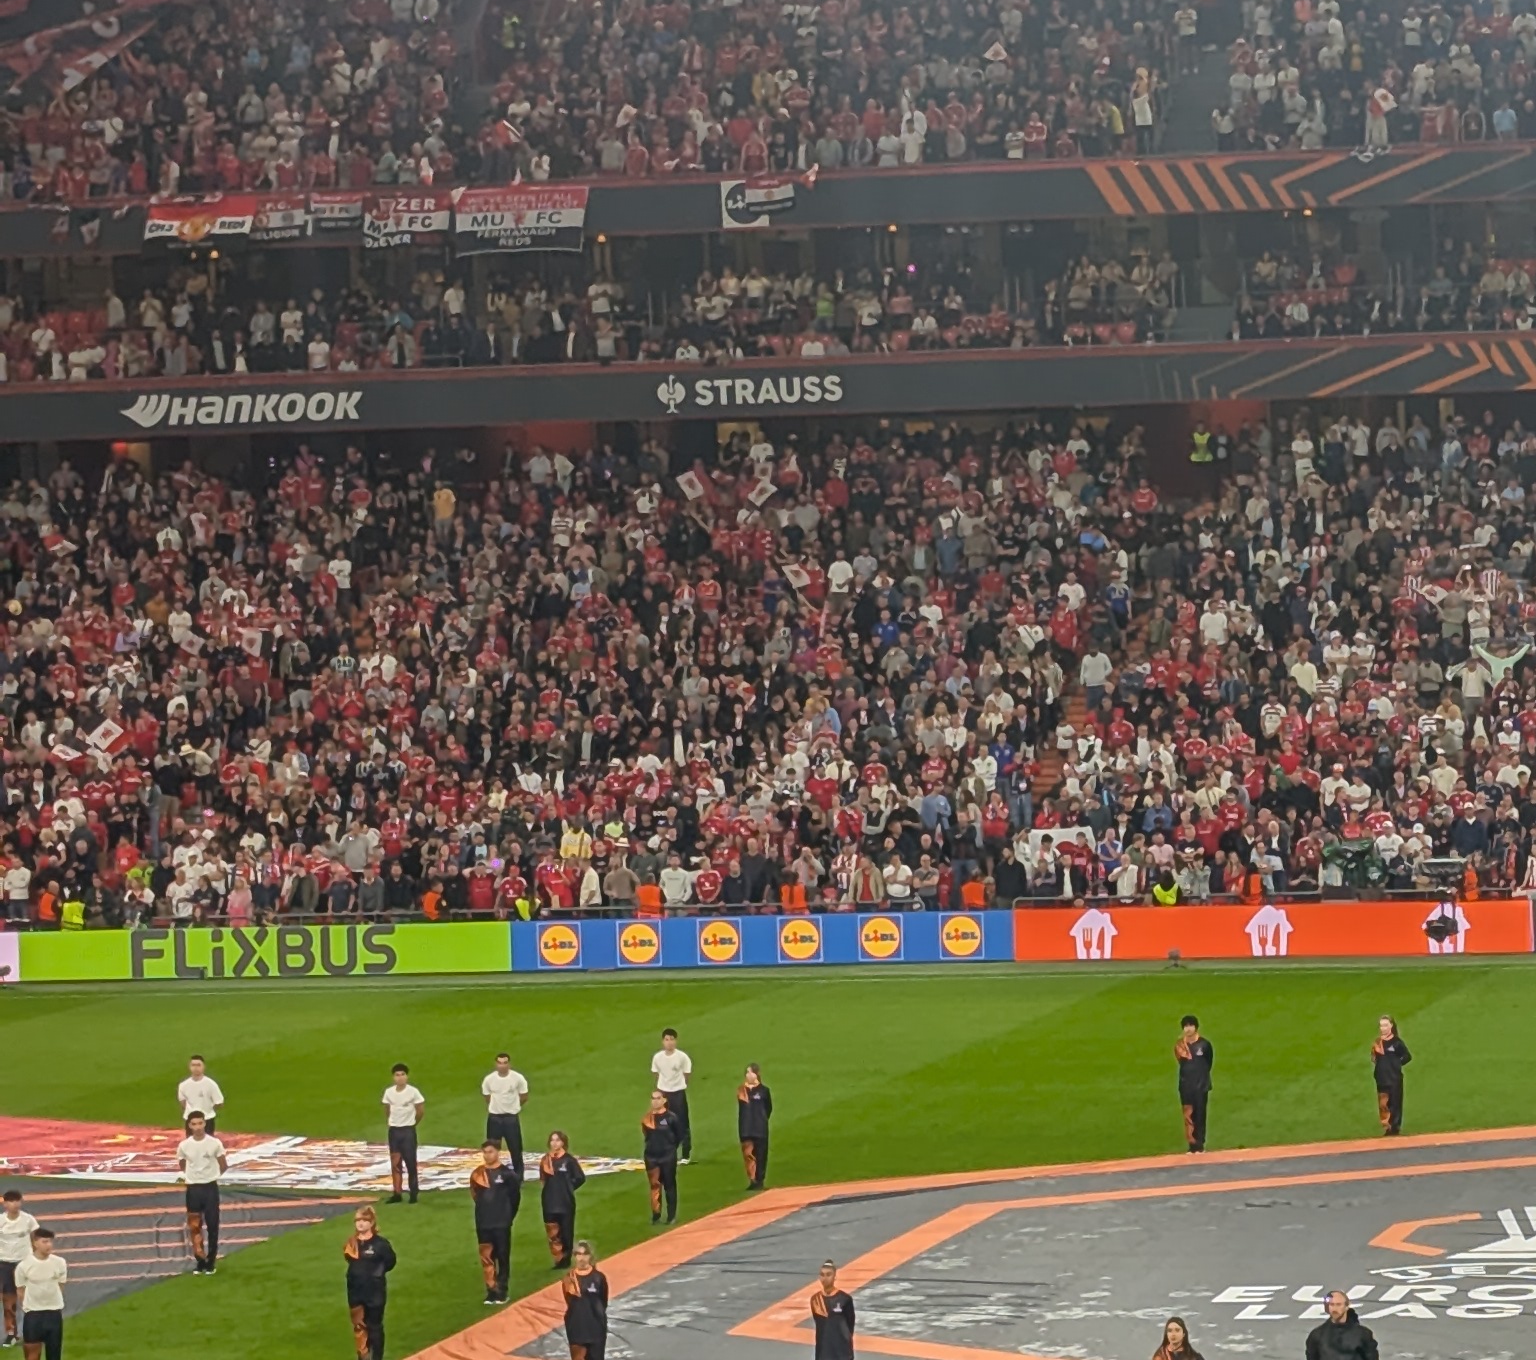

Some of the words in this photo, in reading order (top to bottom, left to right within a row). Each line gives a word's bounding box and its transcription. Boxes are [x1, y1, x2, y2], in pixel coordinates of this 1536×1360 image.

[408, 215, 433, 228] FC
[470, 214, 504, 227] MU
[536, 211, 563, 224] FC
[477, 228, 556, 239] FERMANAGH
[694, 375, 844, 406] STRAUSS
